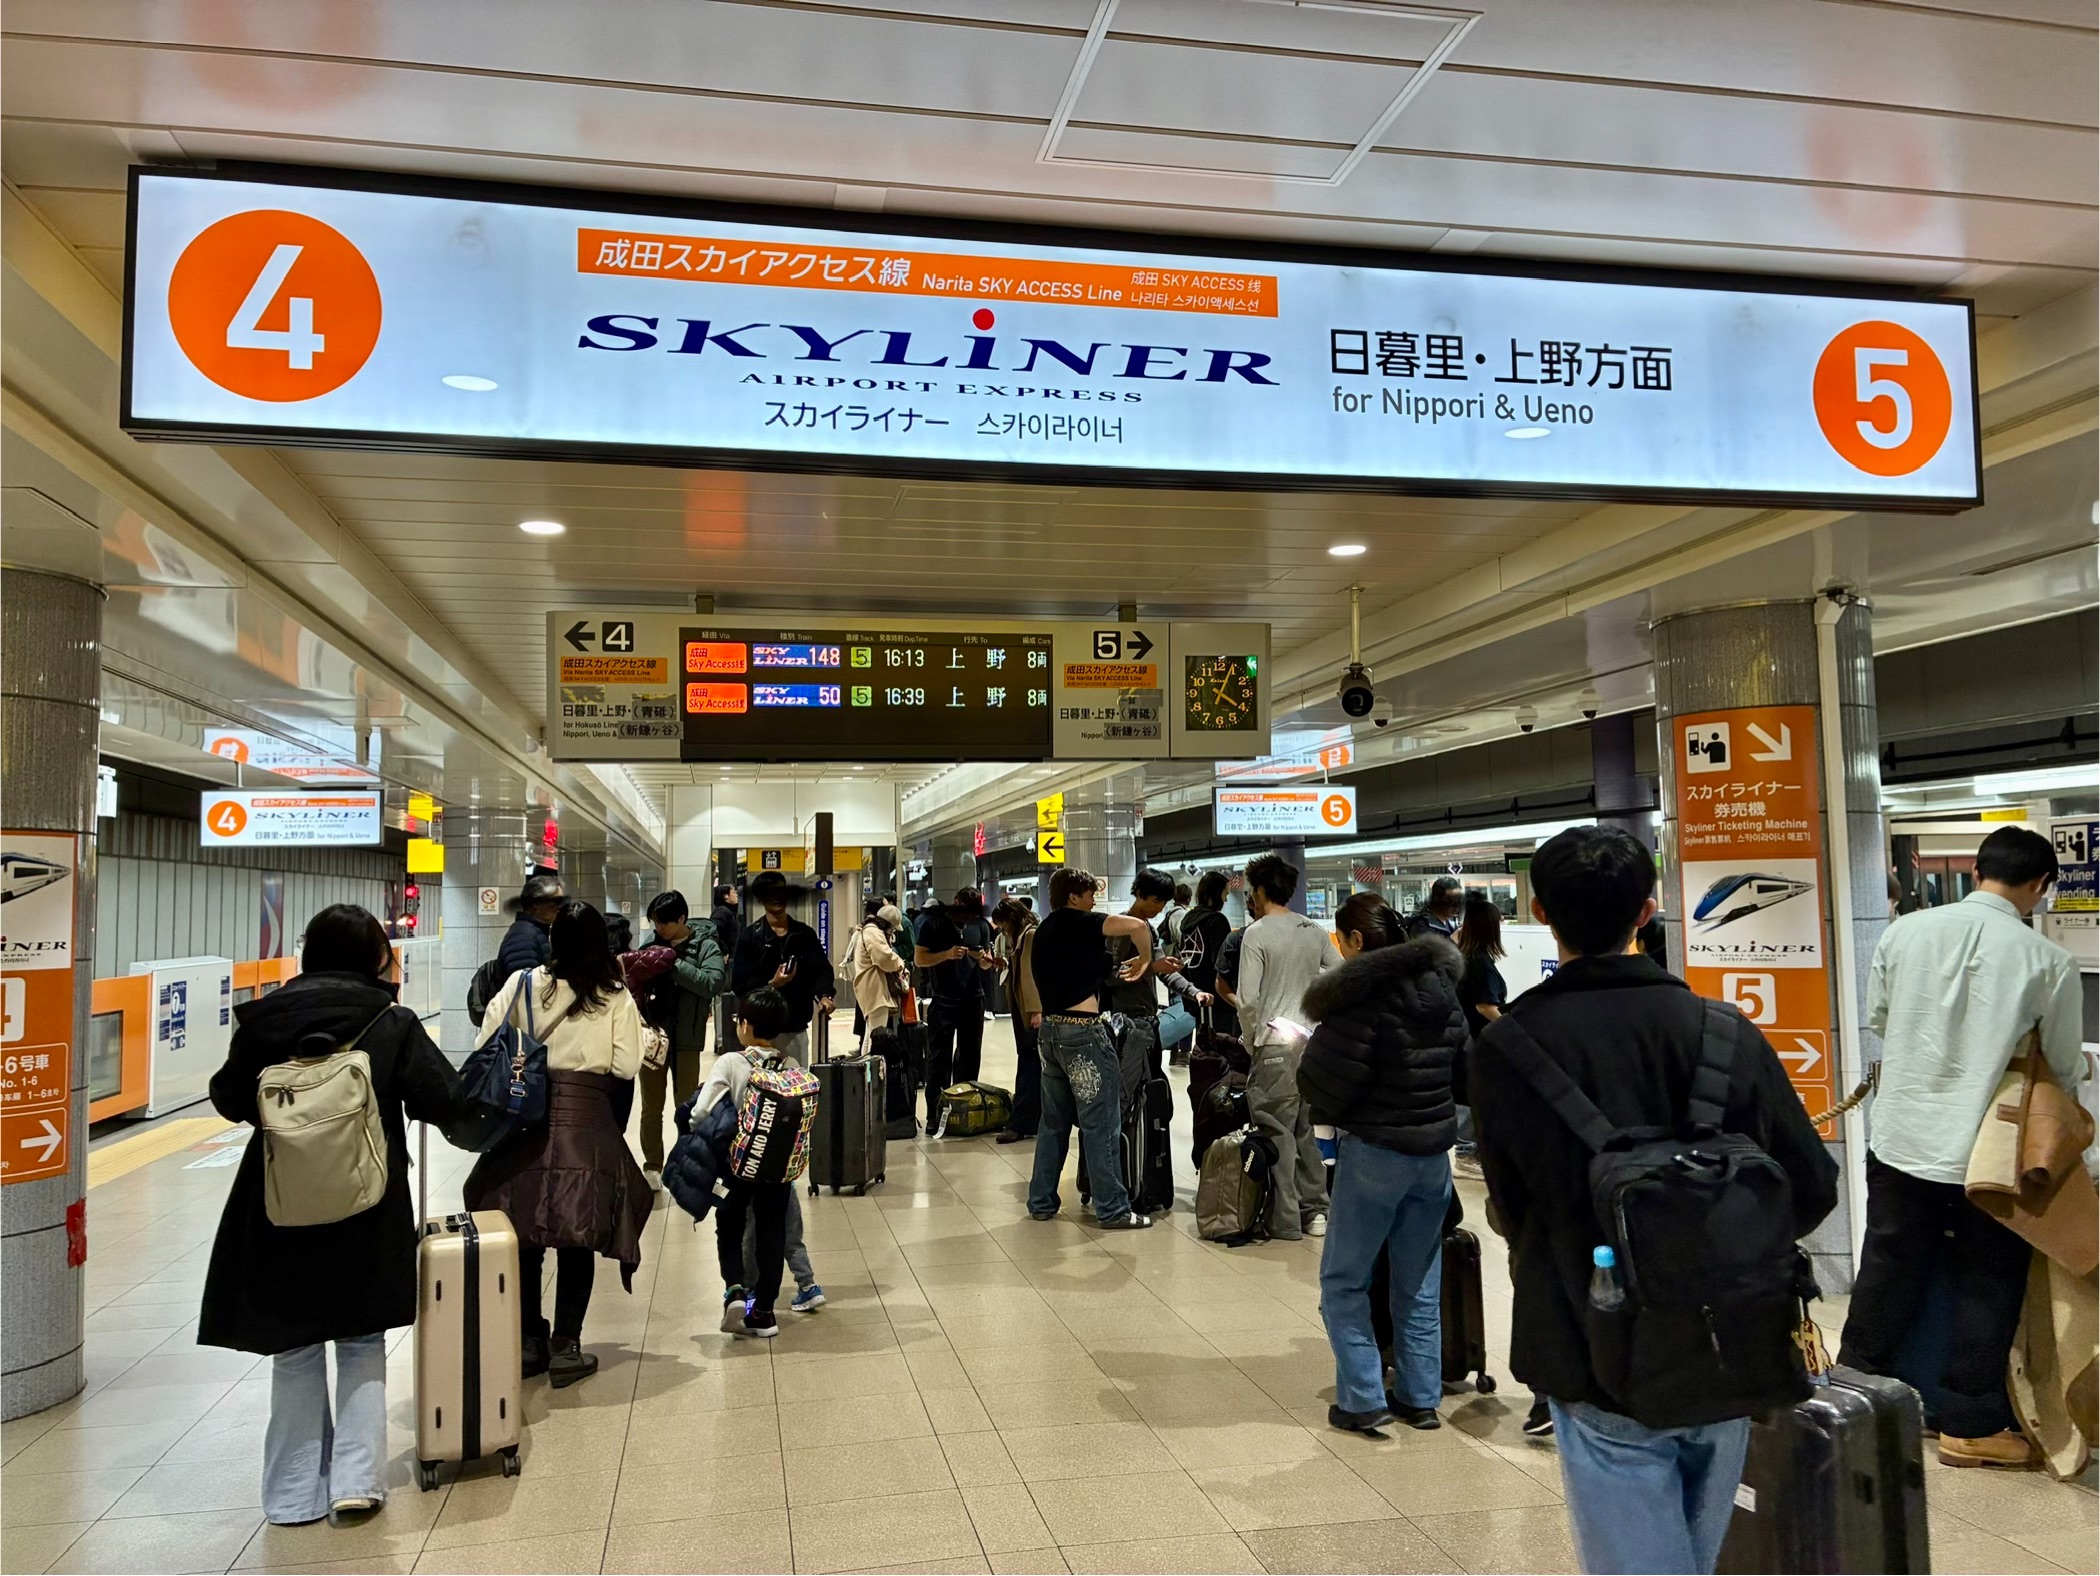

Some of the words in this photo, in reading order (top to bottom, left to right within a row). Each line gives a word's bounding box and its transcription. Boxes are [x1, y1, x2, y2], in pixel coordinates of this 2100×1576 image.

[595, 239, 911, 287] 成田スカイアクセス線
[923, 273, 973, 292] Narita
[978, 276, 1013, 295] SKY
[1016, 280, 1083, 300] ACCESS
[1087, 284, 1122, 302] Line
[1130, 270, 1158, 286] 成田
[1162, 273, 1187, 289] SKY
[1191, 276, 1244, 292] ACCESS
[226, 244, 325, 370] 4
[1130, 291, 1169, 307] 나리타
[1172, 294, 1260, 313] 스카이액세스선
[1330, 328, 1673, 392] 日暮里・上野方面
[739, 373, 938, 392] AIRPORT
[956, 383, 1142, 403] EXPRESS
[1333, 386, 1373, 413] for
[1382, 388, 1485, 425] Nippori
[1495, 393, 1515, 421] &
[1524, 394, 1594, 425] Ueno
[1853, 346, 1913, 449] 5
[764, 401, 949, 433] スカイライナー
[977, 412, 1123, 444] 스카이라이너
[605, 624, 630, 651] 4
[1097, 633, 1117, 658] 5
[563, 659, 657, 669] 成田スカイアクセス線
[809, 647, 840, 666] 148
[856, 649, 868, 665] 5
[884, 648, 925, 667] 16:13
[1066, 665, 1148, 675] 成田スカイアクセス線
[1201, 667, 1213, 676] 11
[1213, 662, 1226, 671] 12
[1193, 677, 1205, 687] 10
[1238, 676, 1247, 685] 2
[819, 687, 841, 705] 50
[856, 688, 868, 704] 5
[884, 687, 925, 705] 16:39
[1189, 689, 1198, 698] 9
[1241, 689, 1250, 698] 3
[1193, 702, 1202, 711] 8
[1238, 702, 1247, 711] 4
[563, 721, 574, 729] for
[1203, 712, 1211, 721] 7
[1215, 716, 1224, 725] 6
[1229, 712, 1237, 721] 5
[1687, 781, 1801, 801] スカイライナー
[217, 806, 237, 831] 4
[1329, 800, 1344, 822] 5
[1714, 801, 1766, 819] 券売機
[1685, 823, 1716, 835] Skyliner
[1718, 820, 1762, 832] Ticketing
[1765, 819, 1808, 830] Machine
[1735, 978, 1764, 1019] 5
[21, 1075, 38, 1087] 1-6
[742, 1157, 756, 1179] TOM
[752, 1133, 768, 1158] AND
[762, 1098, 777, 1134] JERRY
